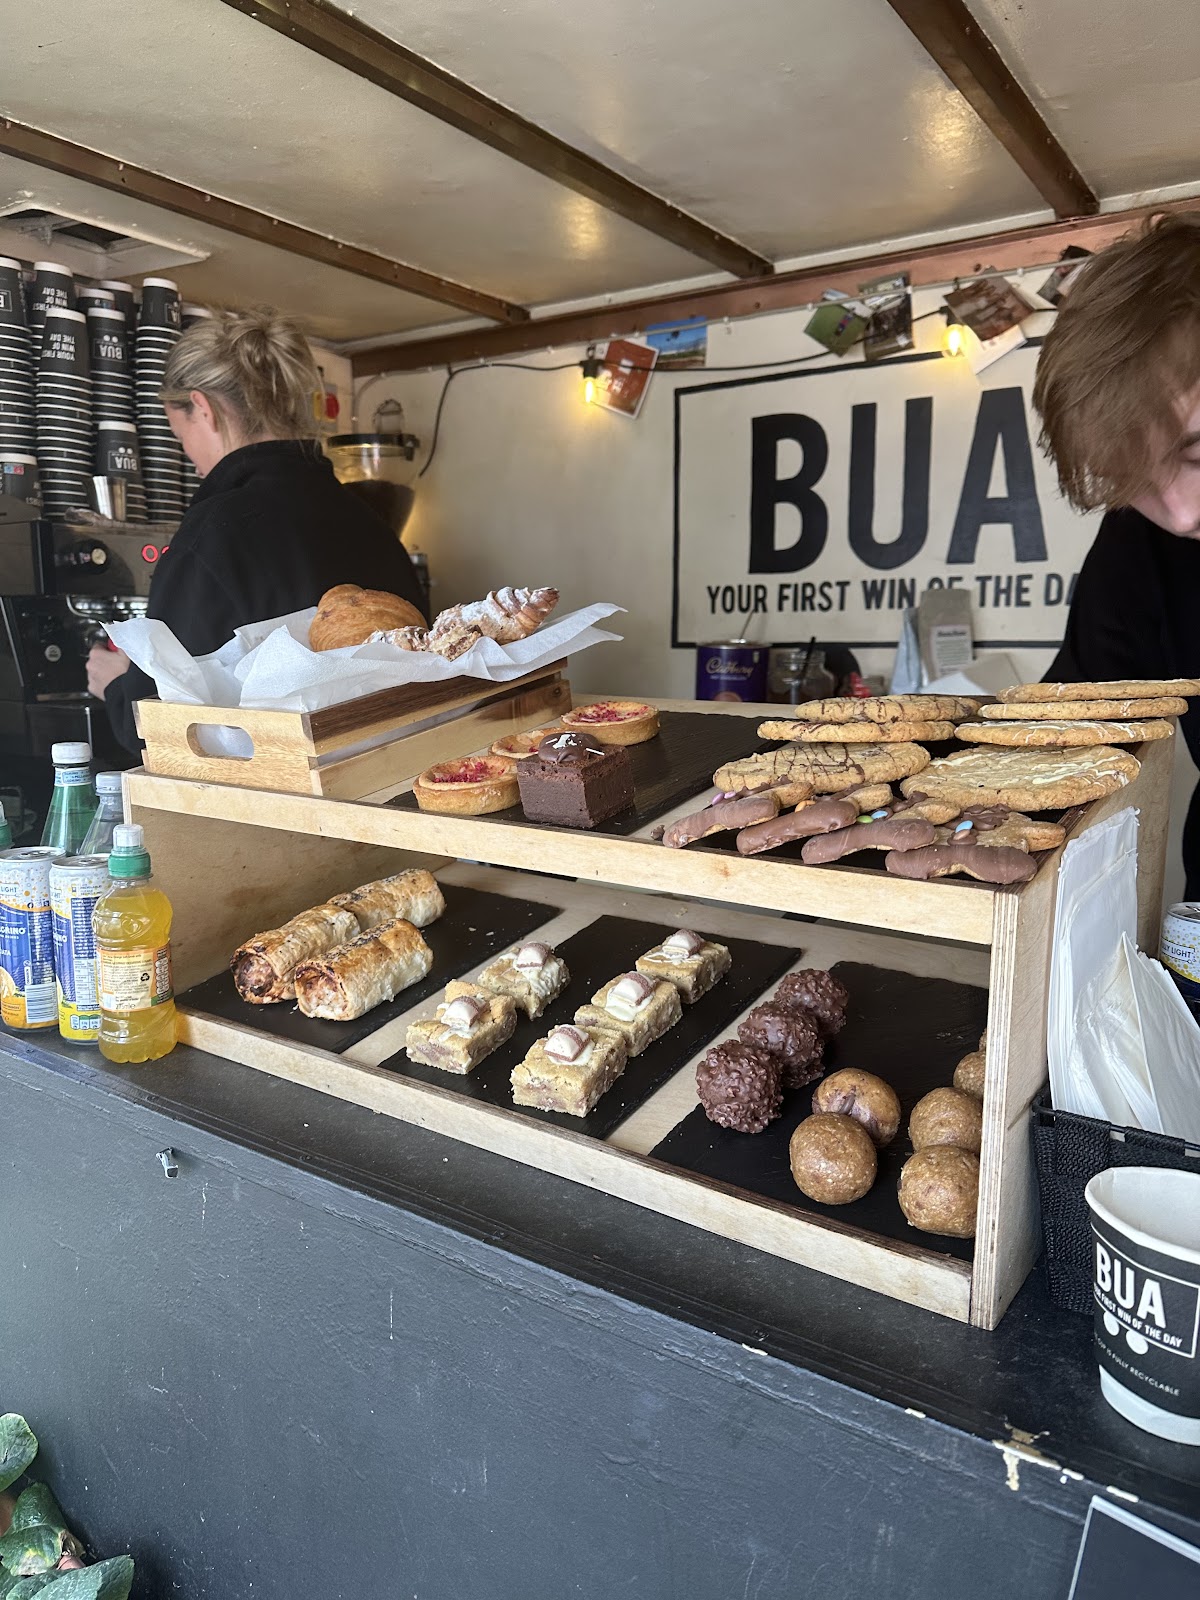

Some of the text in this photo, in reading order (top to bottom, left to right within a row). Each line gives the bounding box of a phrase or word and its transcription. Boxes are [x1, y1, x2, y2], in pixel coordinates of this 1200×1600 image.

[42, 287, 68, 299] THE DAY
[45, 296, 55, 304] OF
[55, 297, 68, 307] WIN
[49, 333, 75, 344] THE DAY
[52, 342, 76, 353] WIN OF
[99, 344, 123, 359] BUA
[56, 350, 75, 361] YOUR
[114, 456, 137, 471] BUA
[748, 386, 1048, 574] BUA
[707, 583, 768, 614] YOUR
[777, 581, 851, 613] FIRST
[862, 578, 916, 610] WIN
[975, 574, 1033, 608] THE
[1171, 946, 1191, 958] LIGHT
[1096, 1242, 1166, 1329] BUA
[1101, 1293, 1116, 1312] FIRST
[1117, 1307, 1132, 1324] WIN
[1132, 1317, 1143, 1330] OF
[1144, 1324, 1162, 1340] THE
[1163, 1333, 1183, 1347] DAY
[1130, 1366, 1180, 1397] RECYCLABLE
